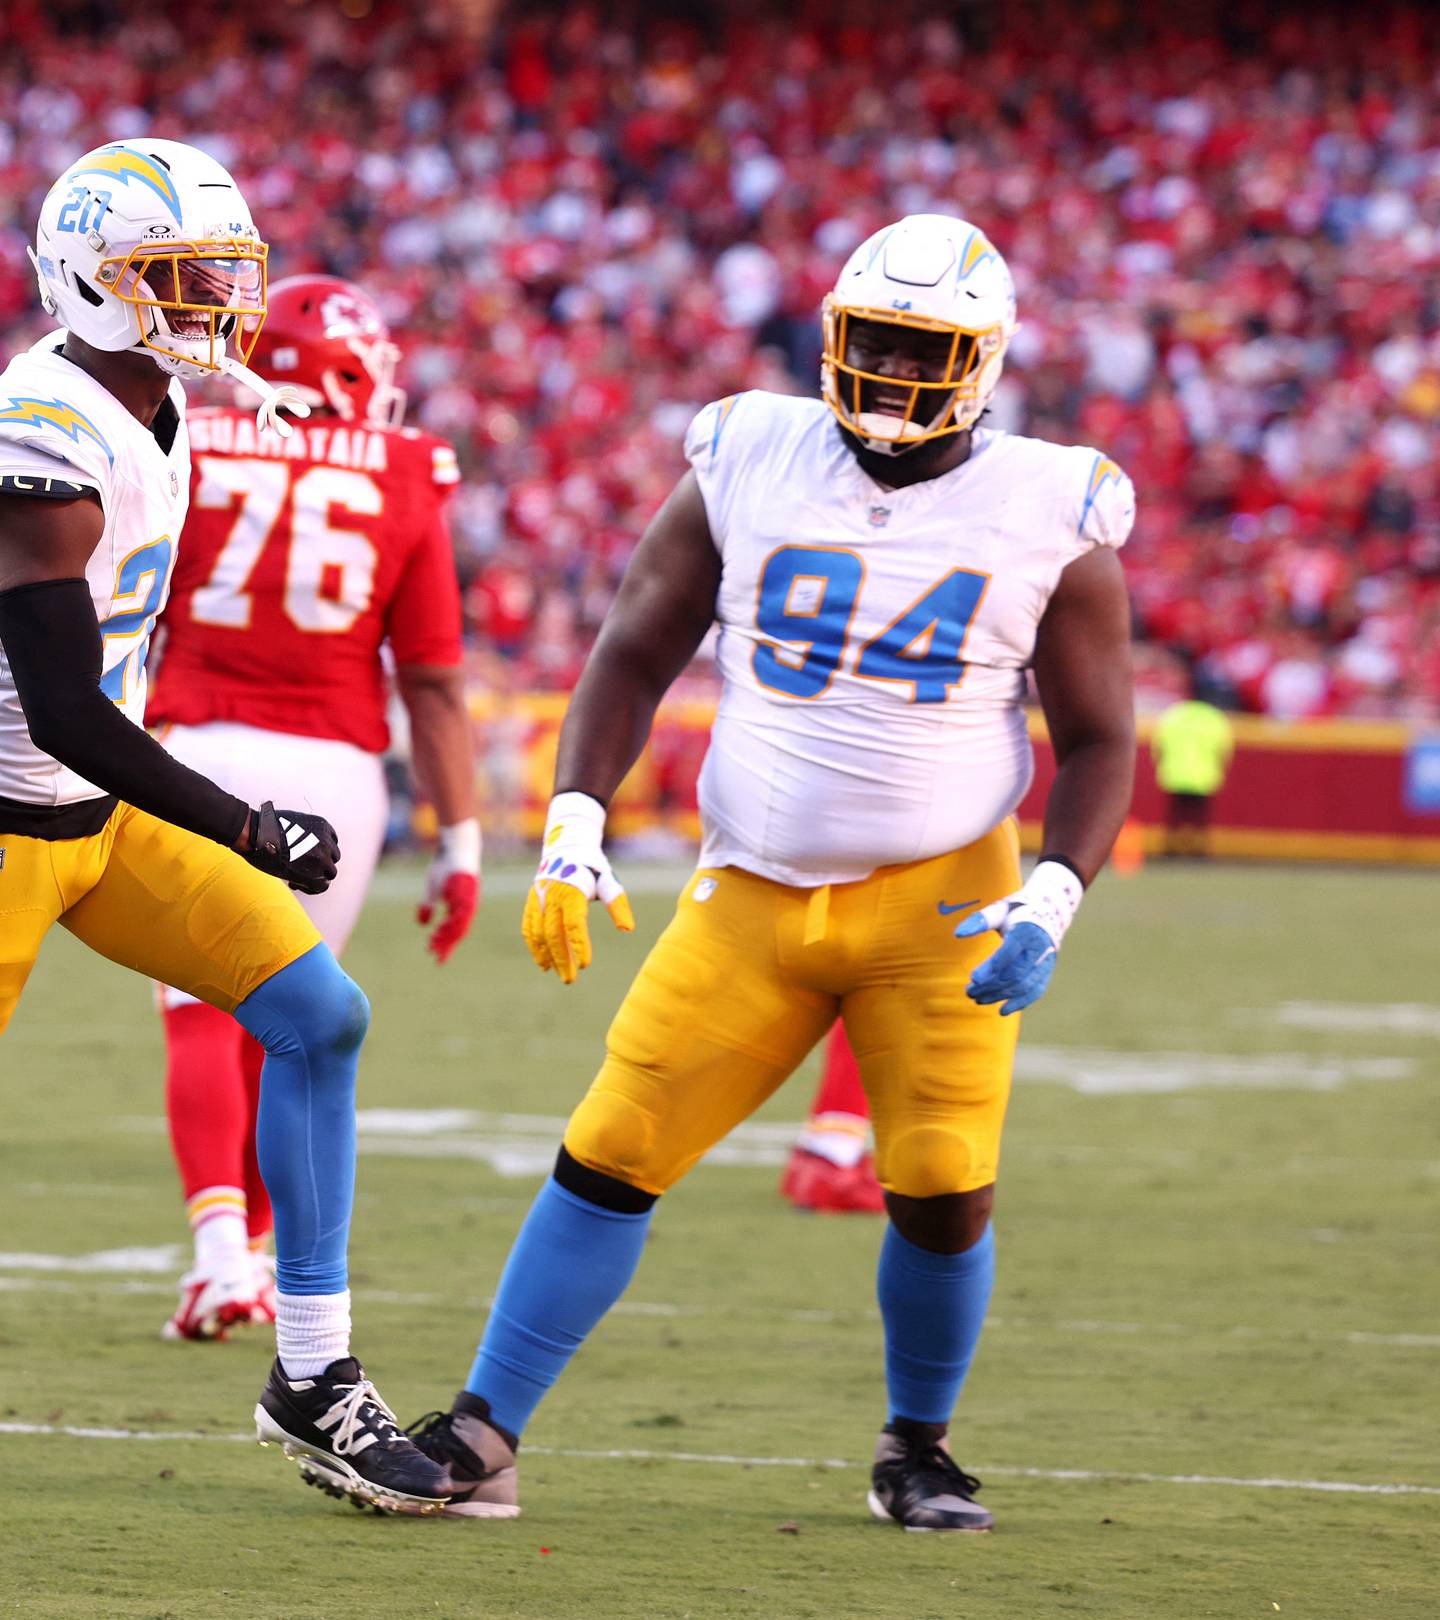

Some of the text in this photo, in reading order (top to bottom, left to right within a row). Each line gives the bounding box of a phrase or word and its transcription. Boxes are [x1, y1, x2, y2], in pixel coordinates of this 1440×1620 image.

[56, 186, 112, 234] 20
[190, 456, 384, 634] 76
[751, 544, 992, 703] 94
